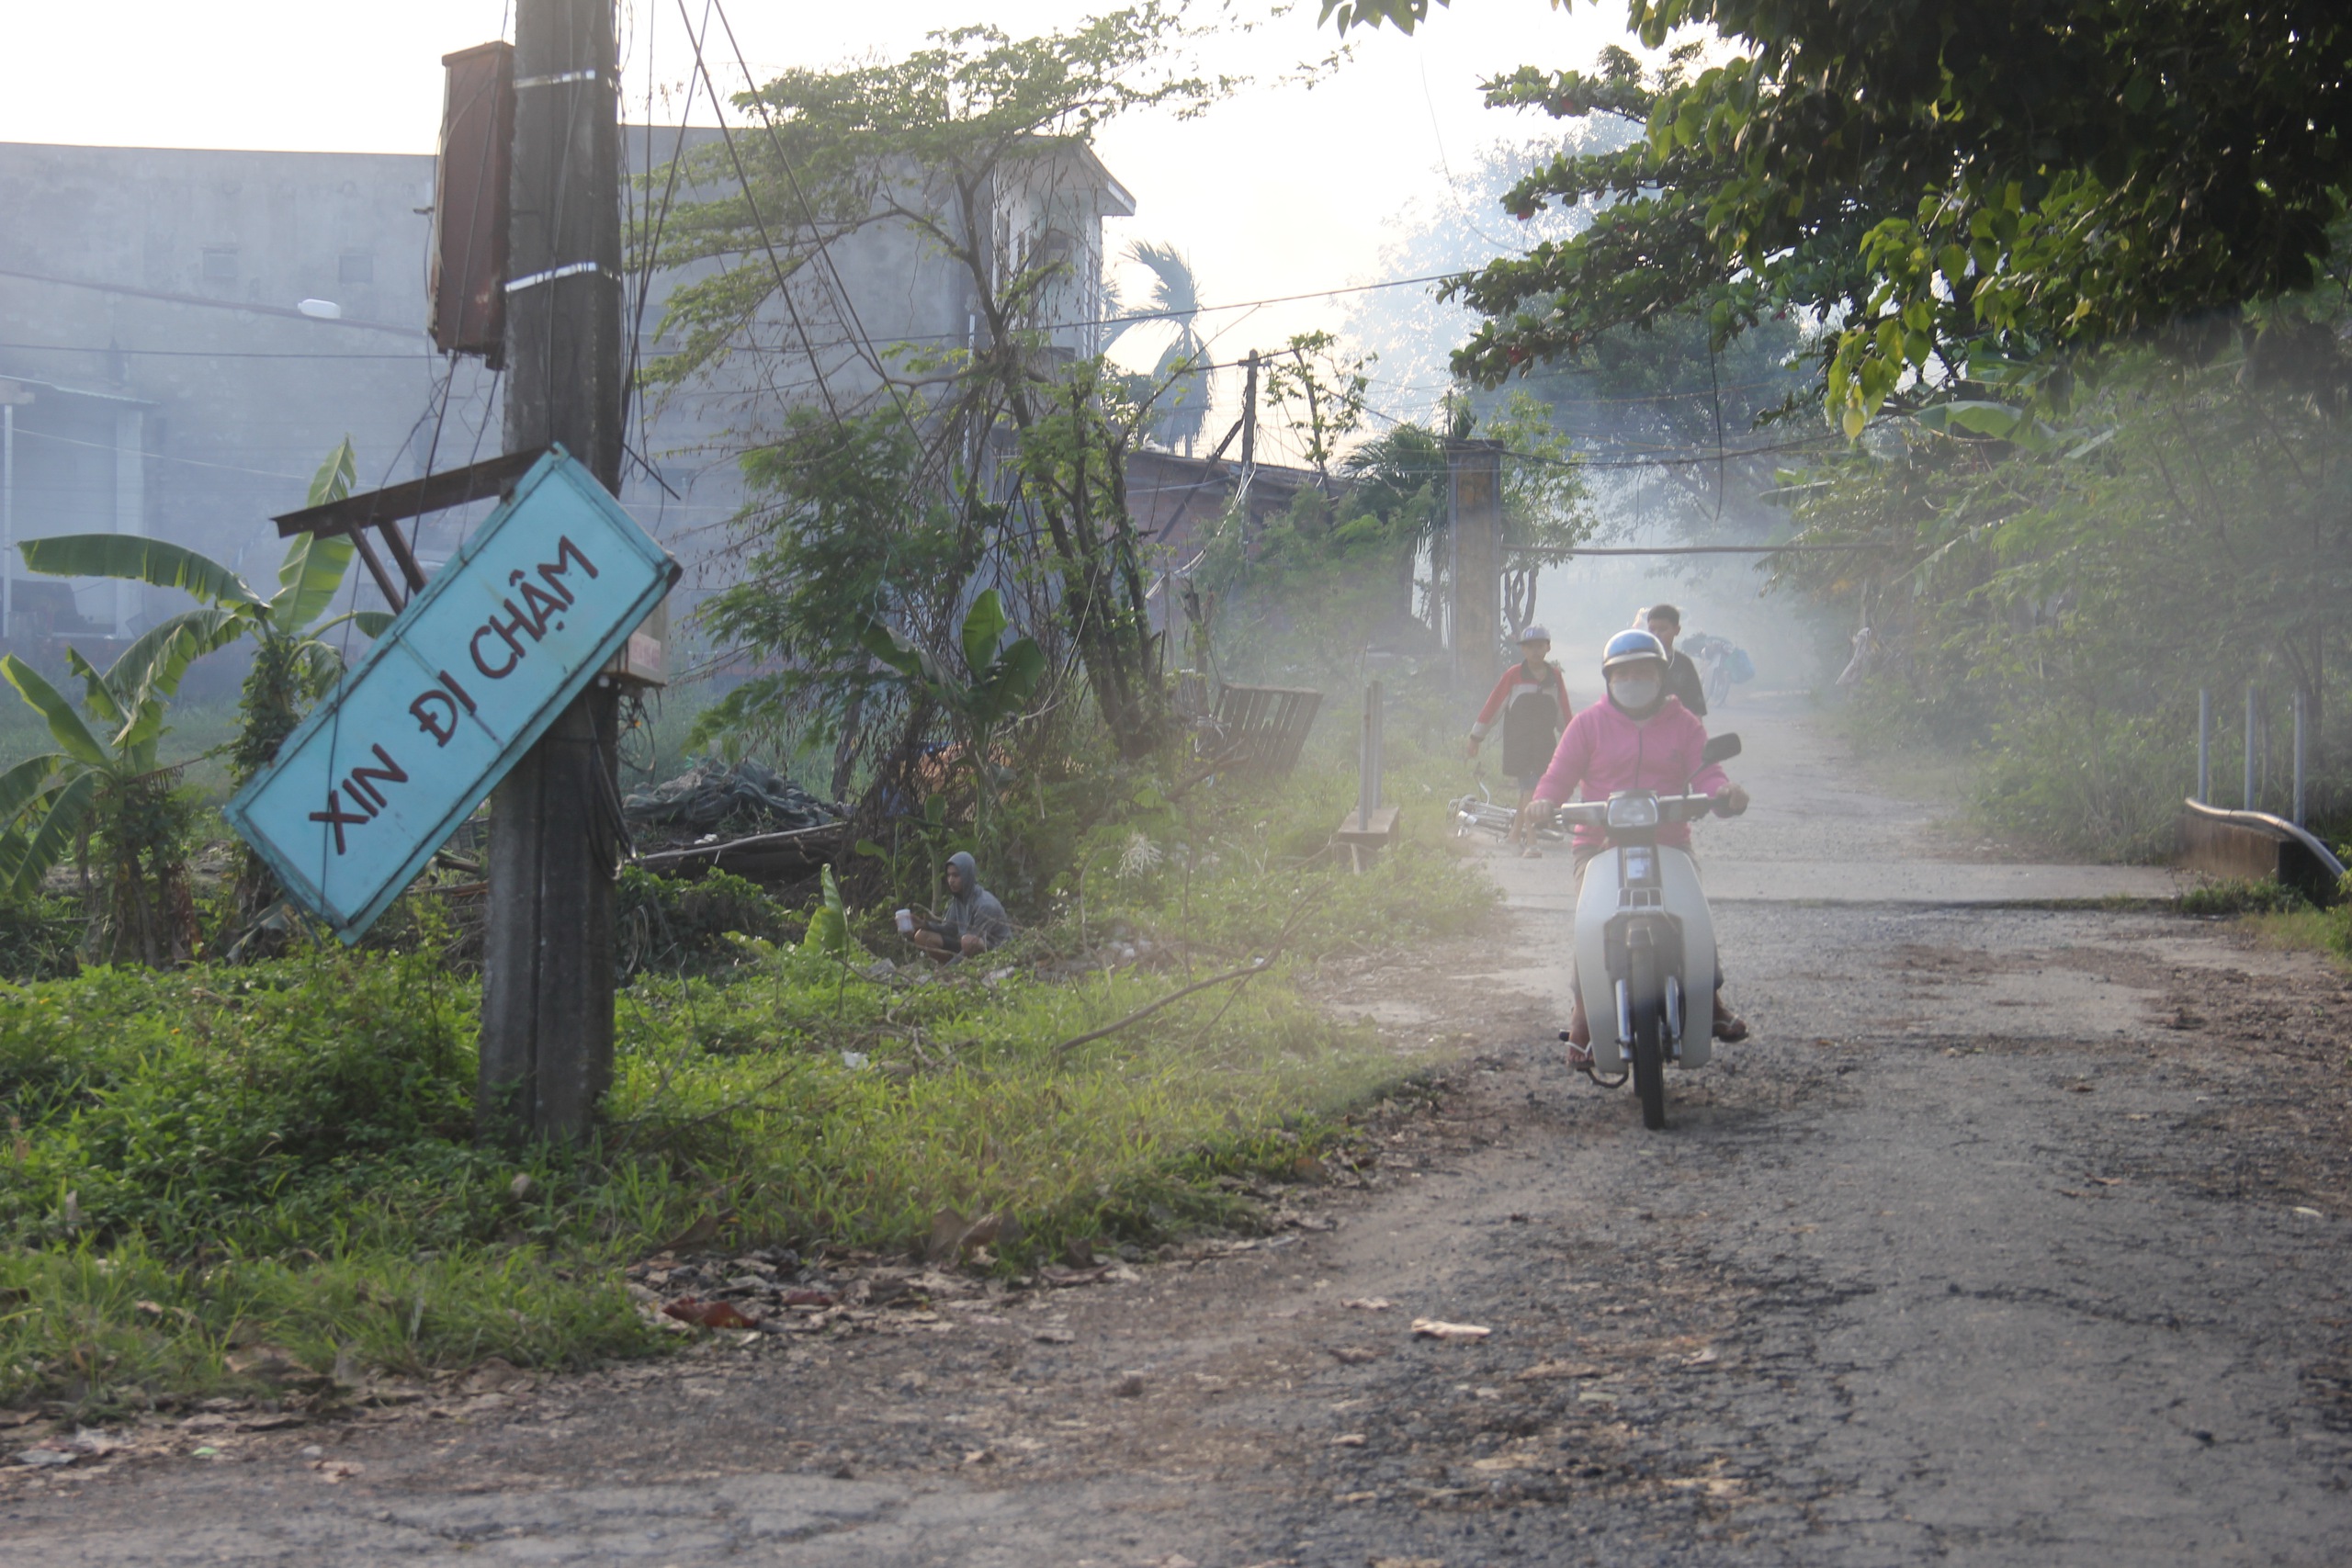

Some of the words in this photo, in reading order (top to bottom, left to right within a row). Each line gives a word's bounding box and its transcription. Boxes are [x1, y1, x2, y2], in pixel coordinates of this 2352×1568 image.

[309, 743, 408, 855] XIN
[410, 671, 477, 747] ĐI
[469, 536, 599, 679] CHẬM
